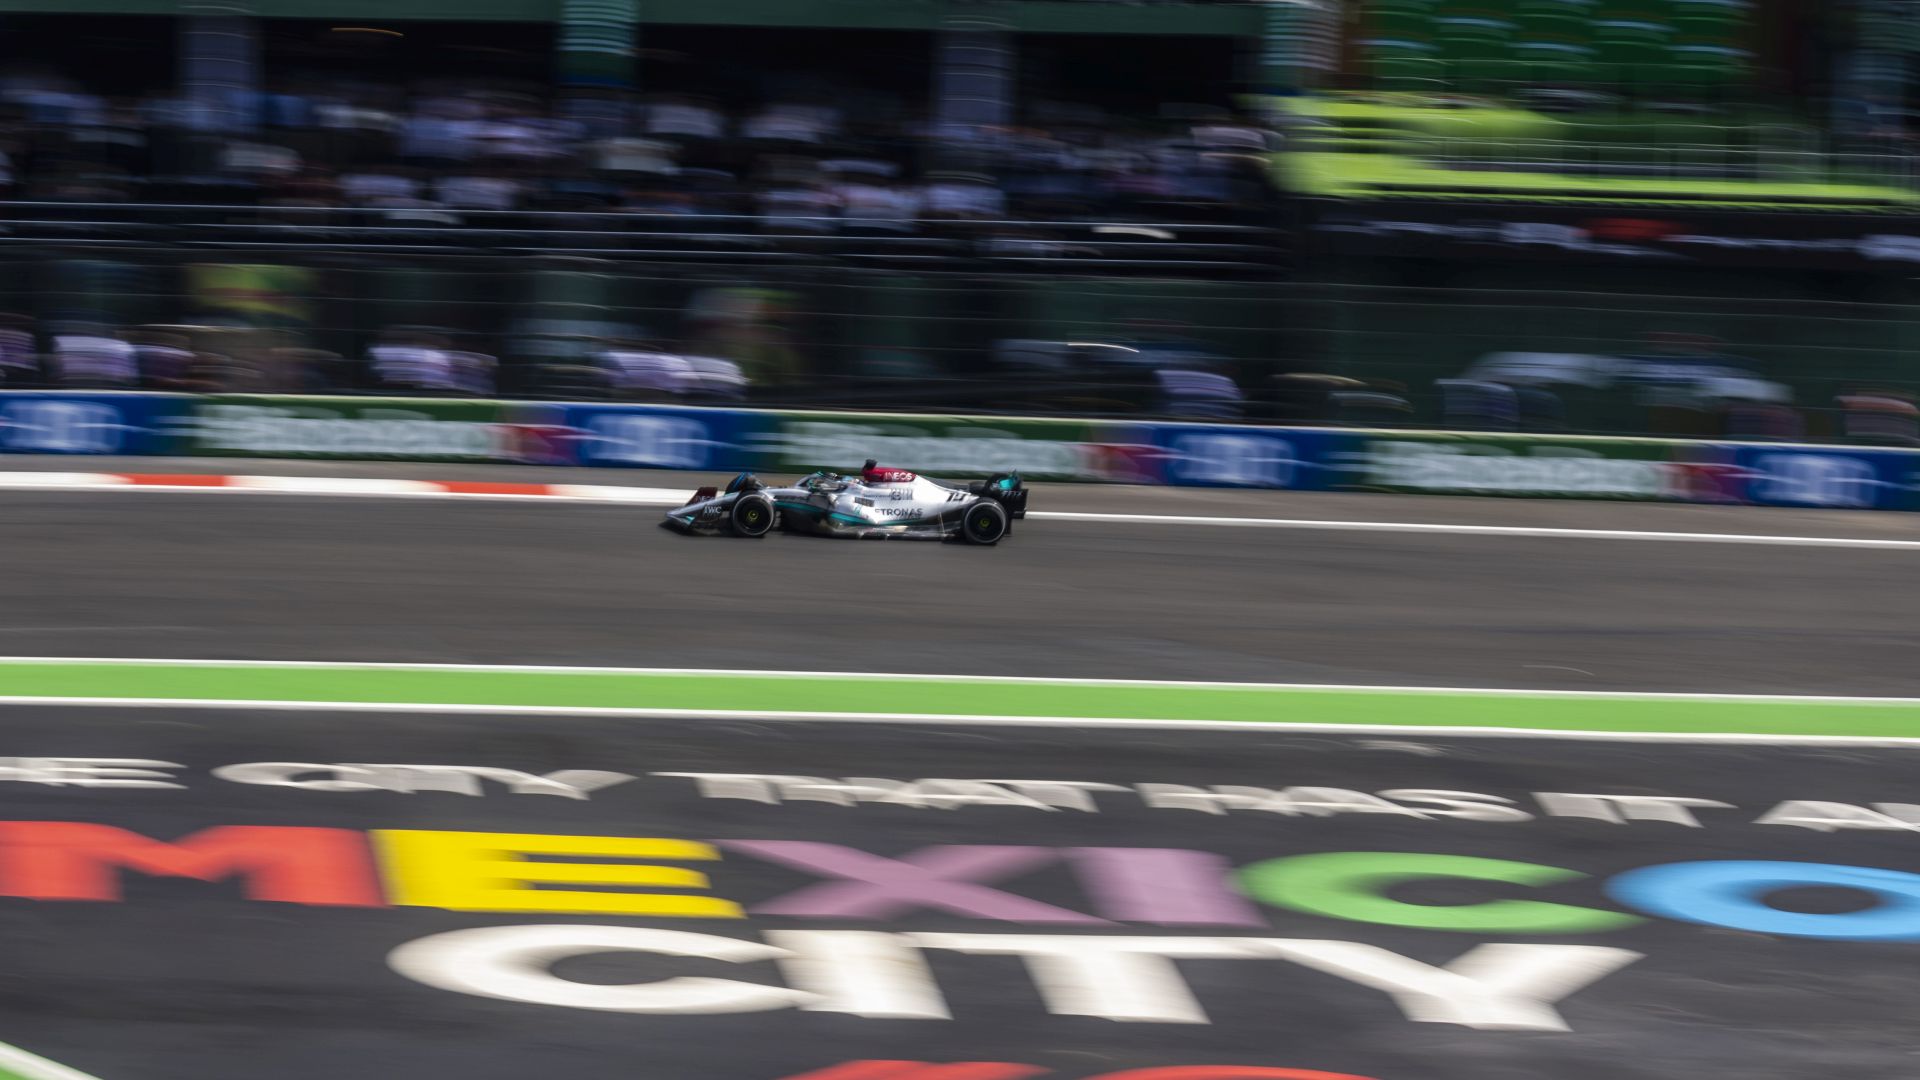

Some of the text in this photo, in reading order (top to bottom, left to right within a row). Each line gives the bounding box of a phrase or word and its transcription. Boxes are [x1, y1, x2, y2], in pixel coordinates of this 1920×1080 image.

[883, 471, 913, 480] INEOS
[210, 762, 639, 800] CITY
[645, 771, 1137, 813] THAT
[1132, 783, 1537, 823] HAS
[1530, 791, 1740, 829] IT
[0, 820, 1920, 941] MEXICO
[386, 924, 1647, 1032] CITY
